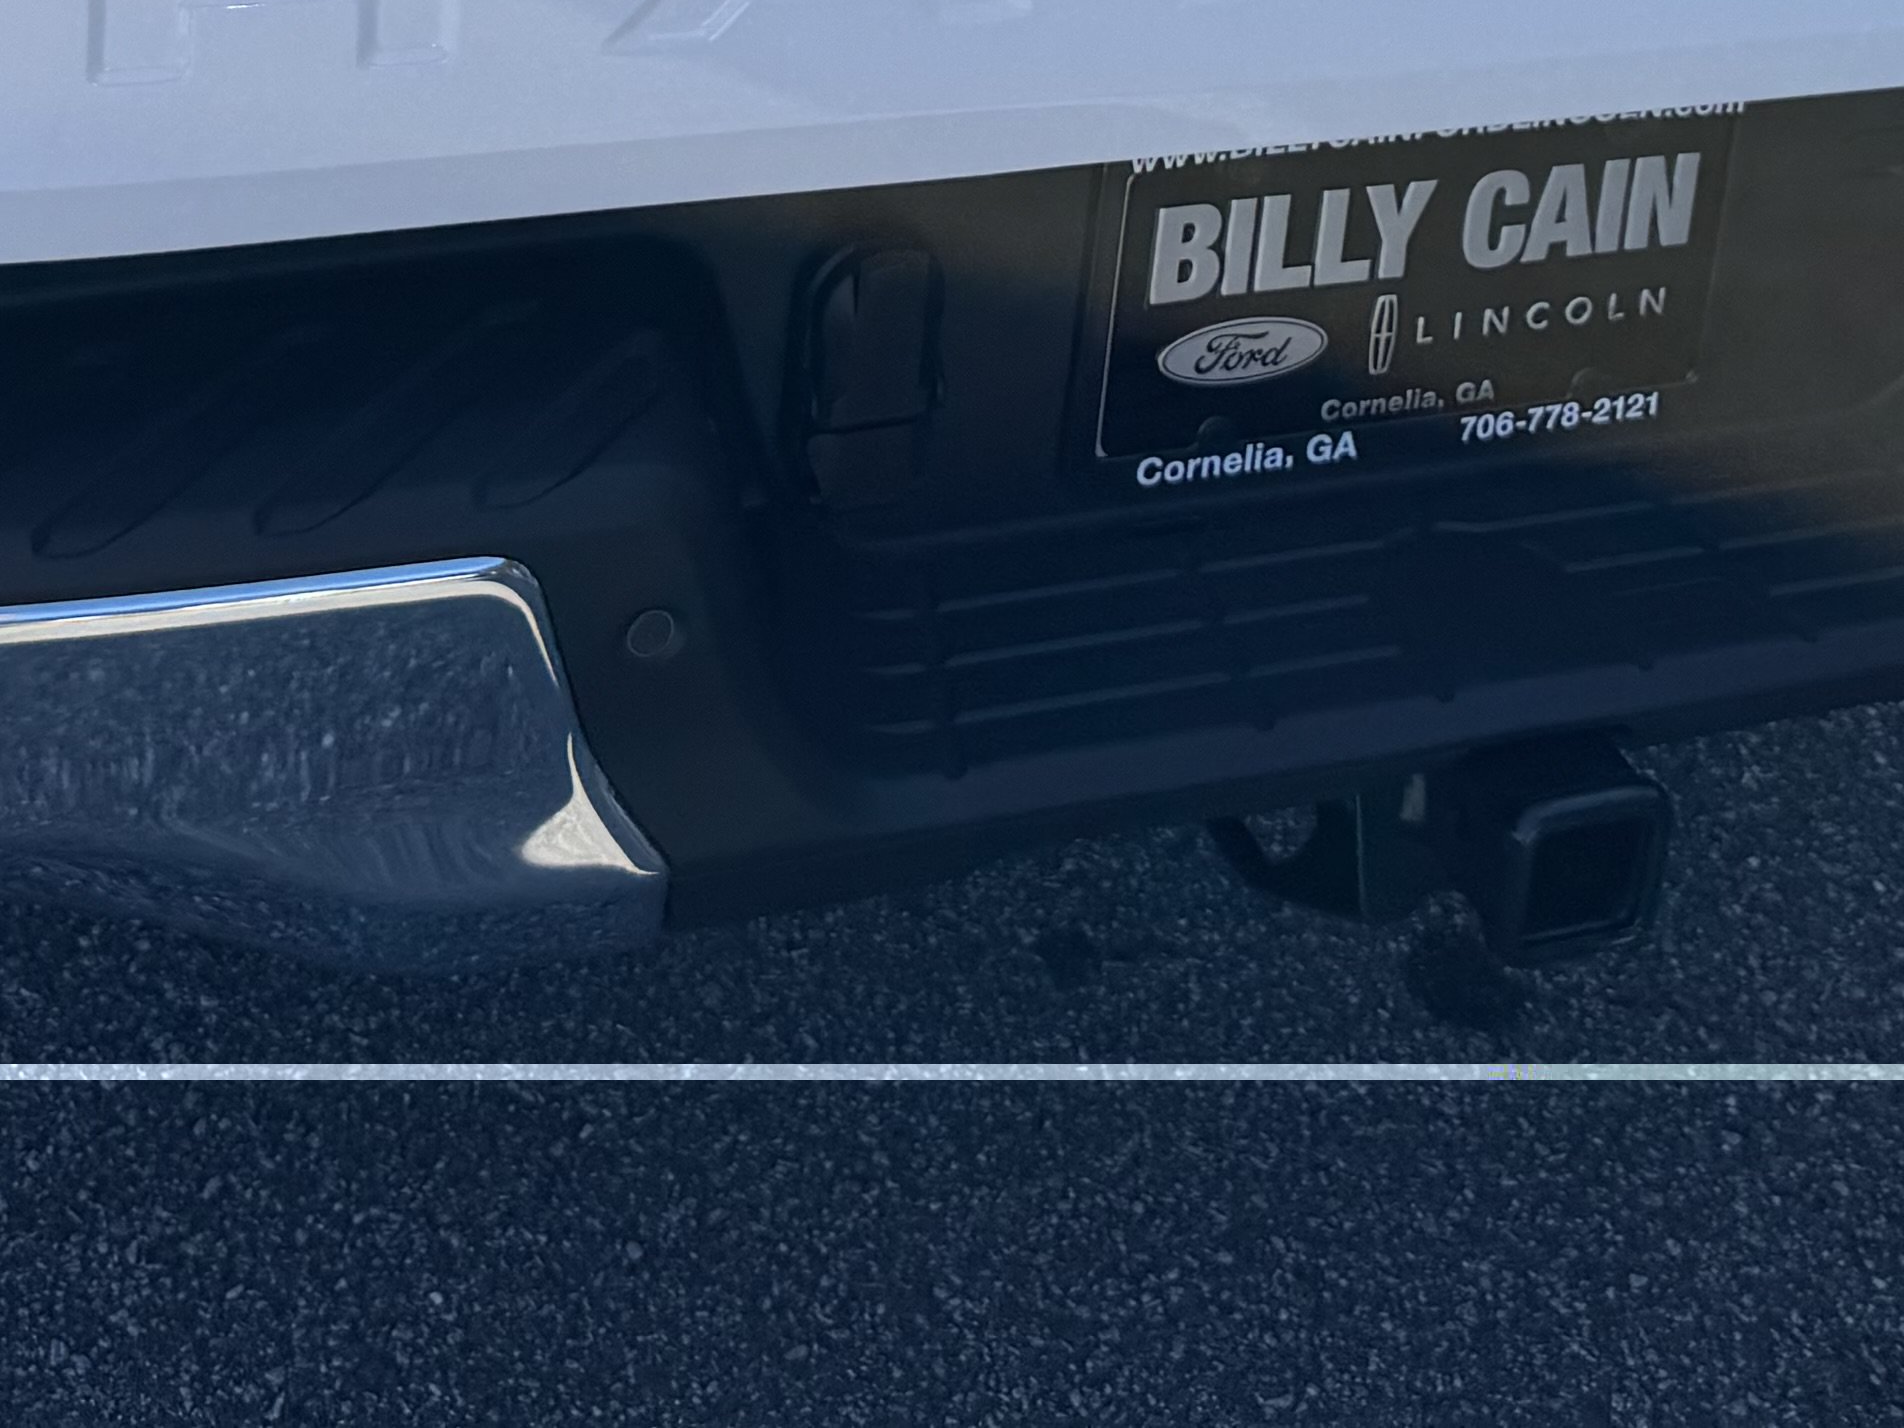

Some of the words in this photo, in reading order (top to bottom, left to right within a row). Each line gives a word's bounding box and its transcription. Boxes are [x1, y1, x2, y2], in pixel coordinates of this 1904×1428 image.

[1149, 180, 1438, 305] BILLY
[1462, 152, 1701, 271] CAIN
[1194, 331, 1293, 375] Ford
[1416, 287, 1667, 344] LINCOLN
[1136, 443, 1294, 487] Cornelia,
[1305, 430, 1358, 465] GA
[1459, 391, 1660, 443] 706-778-2121
[1321, 388, 1444, 423] Cornelia,
[1457, 379, 1495, 405] GA
